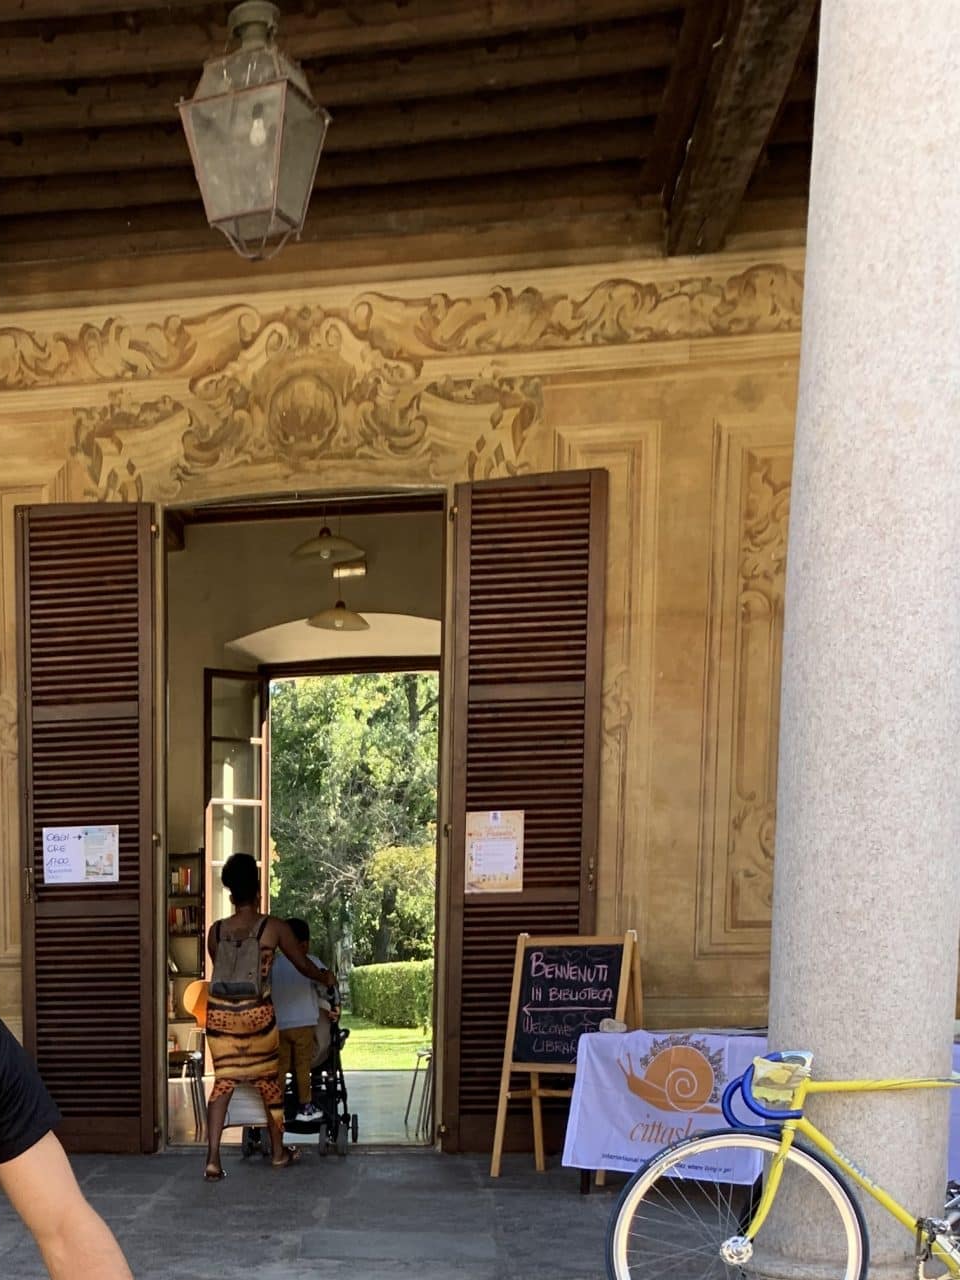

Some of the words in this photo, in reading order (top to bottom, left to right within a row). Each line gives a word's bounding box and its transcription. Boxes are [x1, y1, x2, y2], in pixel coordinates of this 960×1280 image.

[530, 951, 609, 983] BENVENUTI
[531, 986, 542, 1002] IN
[548, 986, 613, 1003] BIBLIOTECA
[532, 1037, 577, 1054] LIBRAR
[630, 1113, 704, 1145] cittasl
